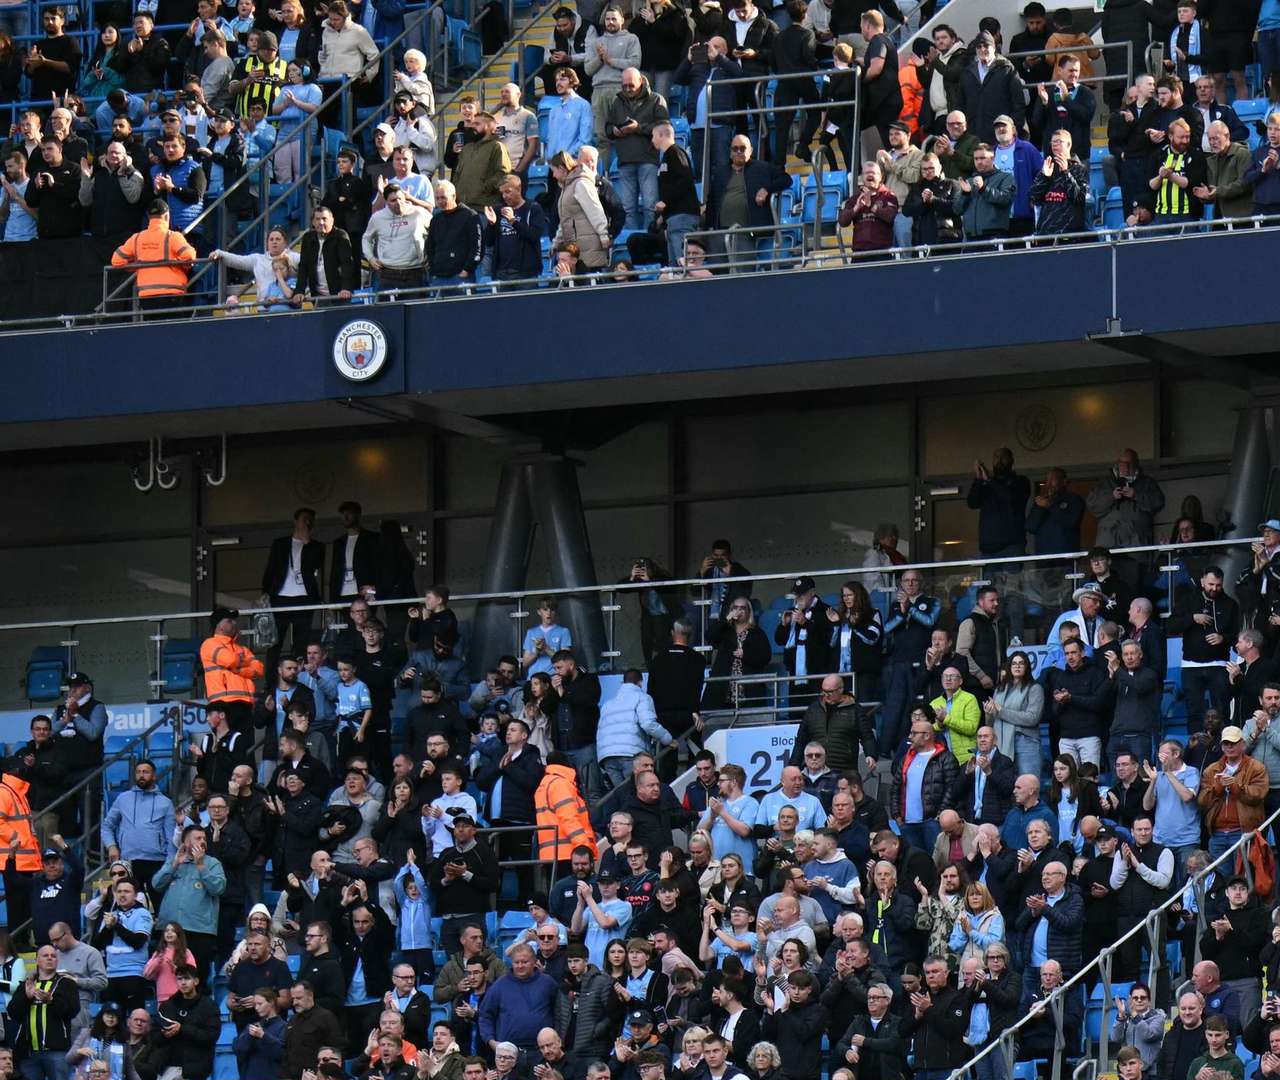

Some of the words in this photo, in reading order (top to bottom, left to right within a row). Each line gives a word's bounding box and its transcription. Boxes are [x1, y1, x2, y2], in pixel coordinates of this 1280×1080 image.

[338, 323, 384, 344] MANCHESTER
[771, 736, 798, 747] Bloc
[750, 749, 791, 787] 21
